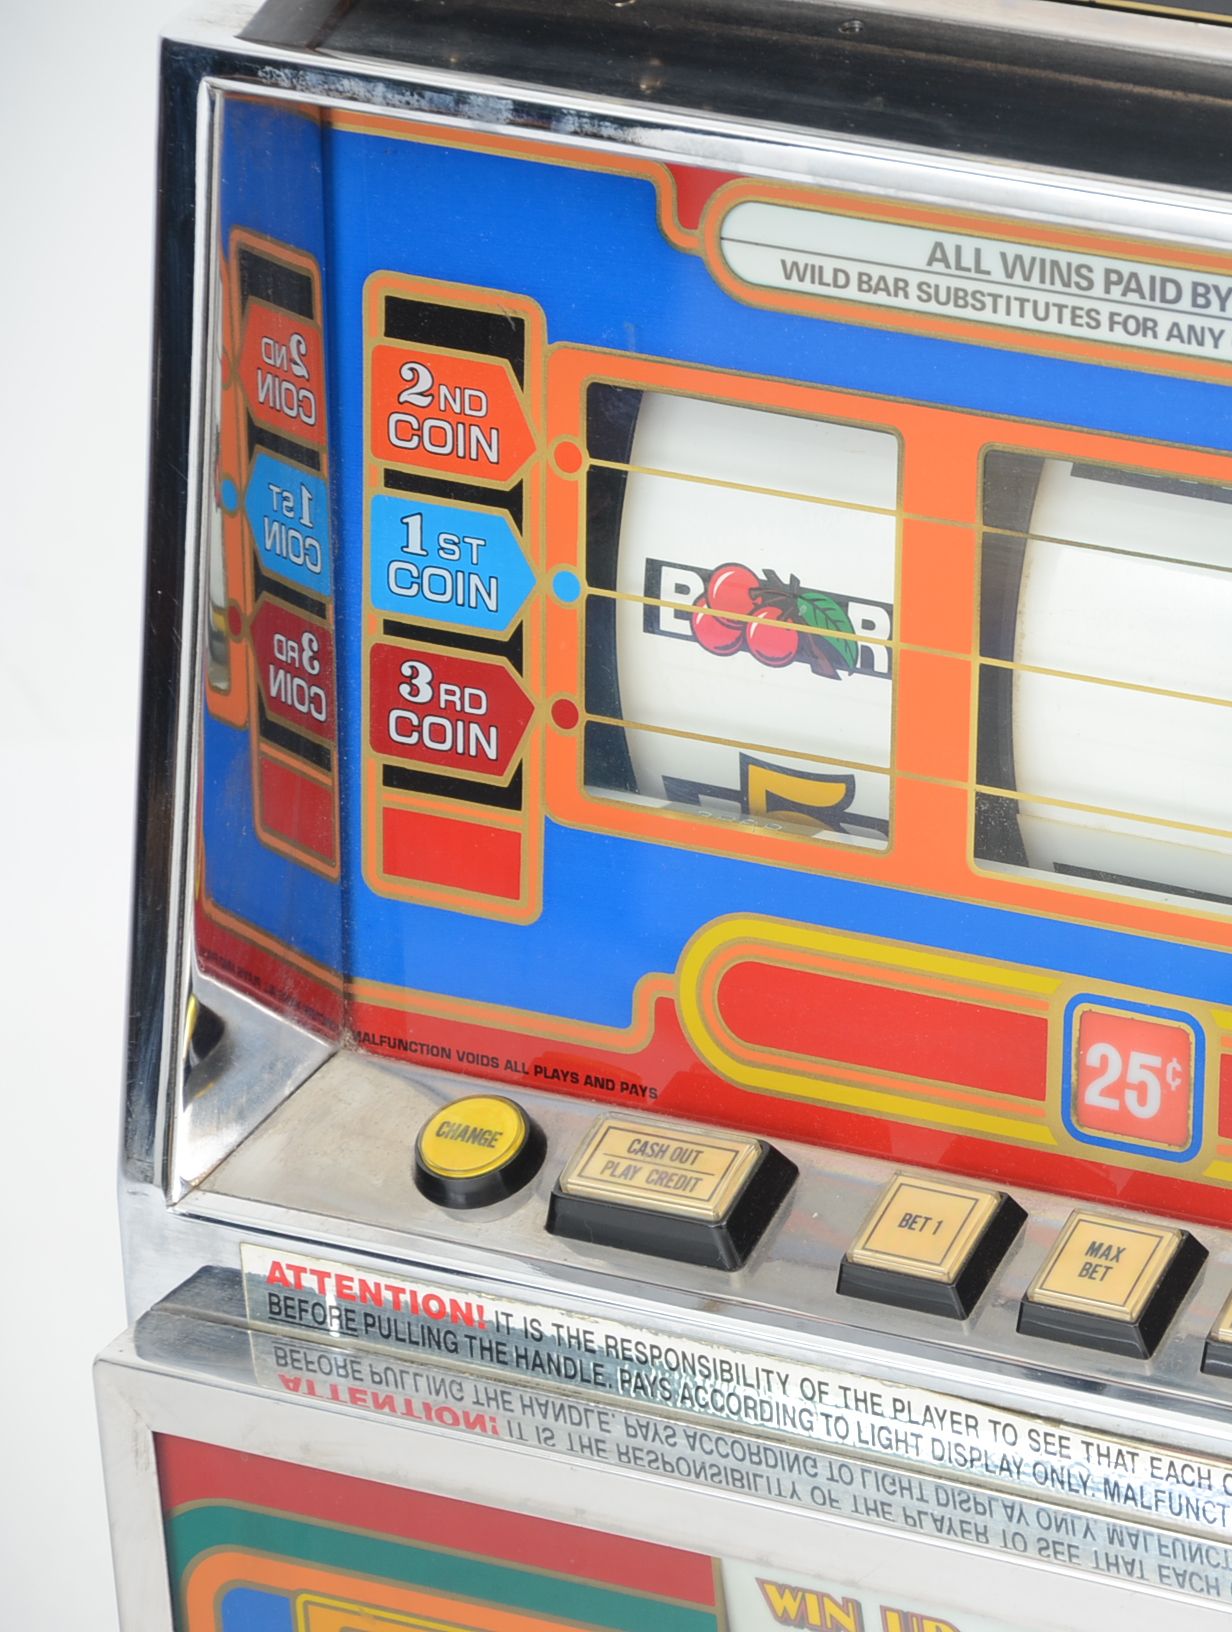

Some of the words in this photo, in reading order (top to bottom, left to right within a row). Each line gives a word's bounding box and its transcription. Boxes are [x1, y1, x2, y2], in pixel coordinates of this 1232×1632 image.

[926, 241, 991, 276] ALL
[1000, 251, 1094, 291] WINS
[1104, 267, 1183, 306] PAID
[780, 258, 850, 289] WILD
[857, 271, 910, 300] BAR
[916, 281, 1101, 330] SUBSTITUTES
[1108, 311, 1159, 340] FOR
[1166, 321, 1225, 349] ANY
[398, 361, 488, 418] 2ND
[387, 412, 499, 464] COIN
[400, 512, 486, 566] 1ST
[387, 560, 499, 612] COIN
[398, 660, 488, 715] 3RD
[387, 707, 498, 760] COIN
[456, 1050, 500, 1069] VOIDS
[503, 1058, 530, 1076] ALL
[534, 1064, 580, 1086] PLAYS
[584, 1072, 616, 1091] AND
[620, 1080, 659, 1100] PAYS
[435, 1120, 503, 1149] CHANGE
[626, 1137, 668, 1160] CASH
[669, 1145, 705, 1166] OUT
[600, 1160, 641, 1182] PLAY
[644, 1168, 704, 1193] CREDIT
[898, 1212, 931, 1233] BET
[934, 1219, 944, 1236] 1
[1078, 1262, 1113, 1282] BET
[1085, 1240, 1127, 1264] MAX
[265, 1260, 487, 1329] ATTENTION!
[494, 1310, 513, 1332] IT
[523, 1315, 544, 1343] IS
[551, 1322, 596, 1355] THE
[605, 1335, 790, 1393] RESPONSIBILITY
[800, 1376, 829, 1402] OF
[838, 1385, 883, 1417] THE
[892, 1397, 979, 1439] PLAYER
[988, 1418, 1018, 1448] TO
[1028, 1428, 1072, 1460] SEE
[1081, 1440, 1140, 1475] THAT
[1150, 1456, 1212, 1491] EACH
[268, 1292, 358, 1334] BEFORE
[363, 1312, 459, 1354] PULLING
[464, 1334, 511, 1365] THE
[515, 1345, 613, 1388] HANDLE.
[620, 1367, 672, 1401] PAYS
[680, 1380, 814, 1432] ACCORDING
[820, 1411, 849, 1439] TO
[857, 1421, 923, 1456] LIGHT
[931, 1440, 1025, 1480] DISPLAY
[755, 1577, 864, 1632] WIN
